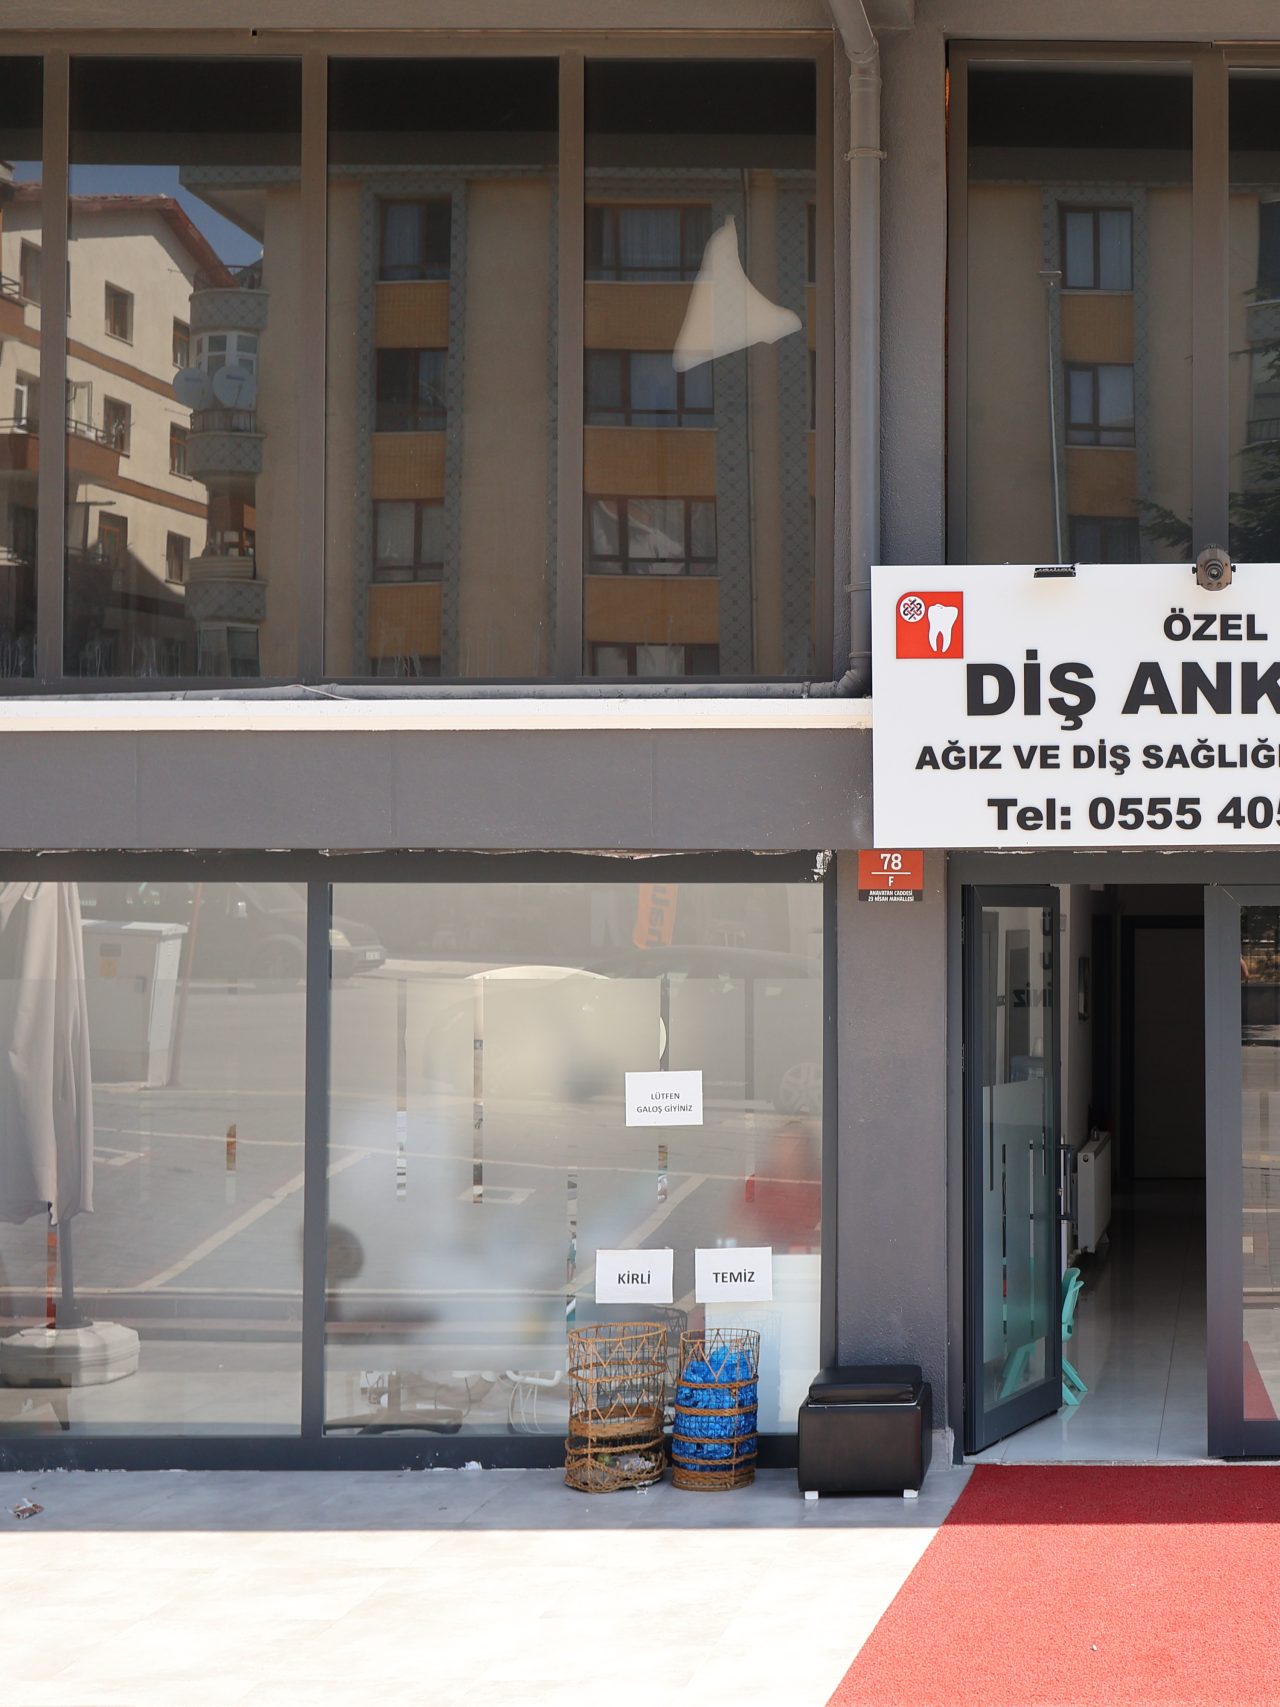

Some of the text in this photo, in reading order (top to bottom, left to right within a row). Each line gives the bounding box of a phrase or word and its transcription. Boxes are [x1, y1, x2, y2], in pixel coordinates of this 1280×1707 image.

[1163, 607, 1268, 642] ÖZEL
[966, 649, 1096, 731] DİŞ
[915, 739, 1002, 771] AĞIZ
[1013, 745, 1061, 770] VE
[1072, 738, 1131, 776] DİŞ
[987, 797, 1071, 831] Tel:
[1088, 796, 1202, 831] 0555
[880, 853, 902, 871] 78
[888, 876, 895, 887] F
[651, 1092, 680, 1100] LÜTFEN
[636, 1103, 693, 1114] GALOŞ GİYİNİZ
[617, 1270, 651, 1285] KİRLİ
[712, 1269, 755, 1284] TEMİZ
